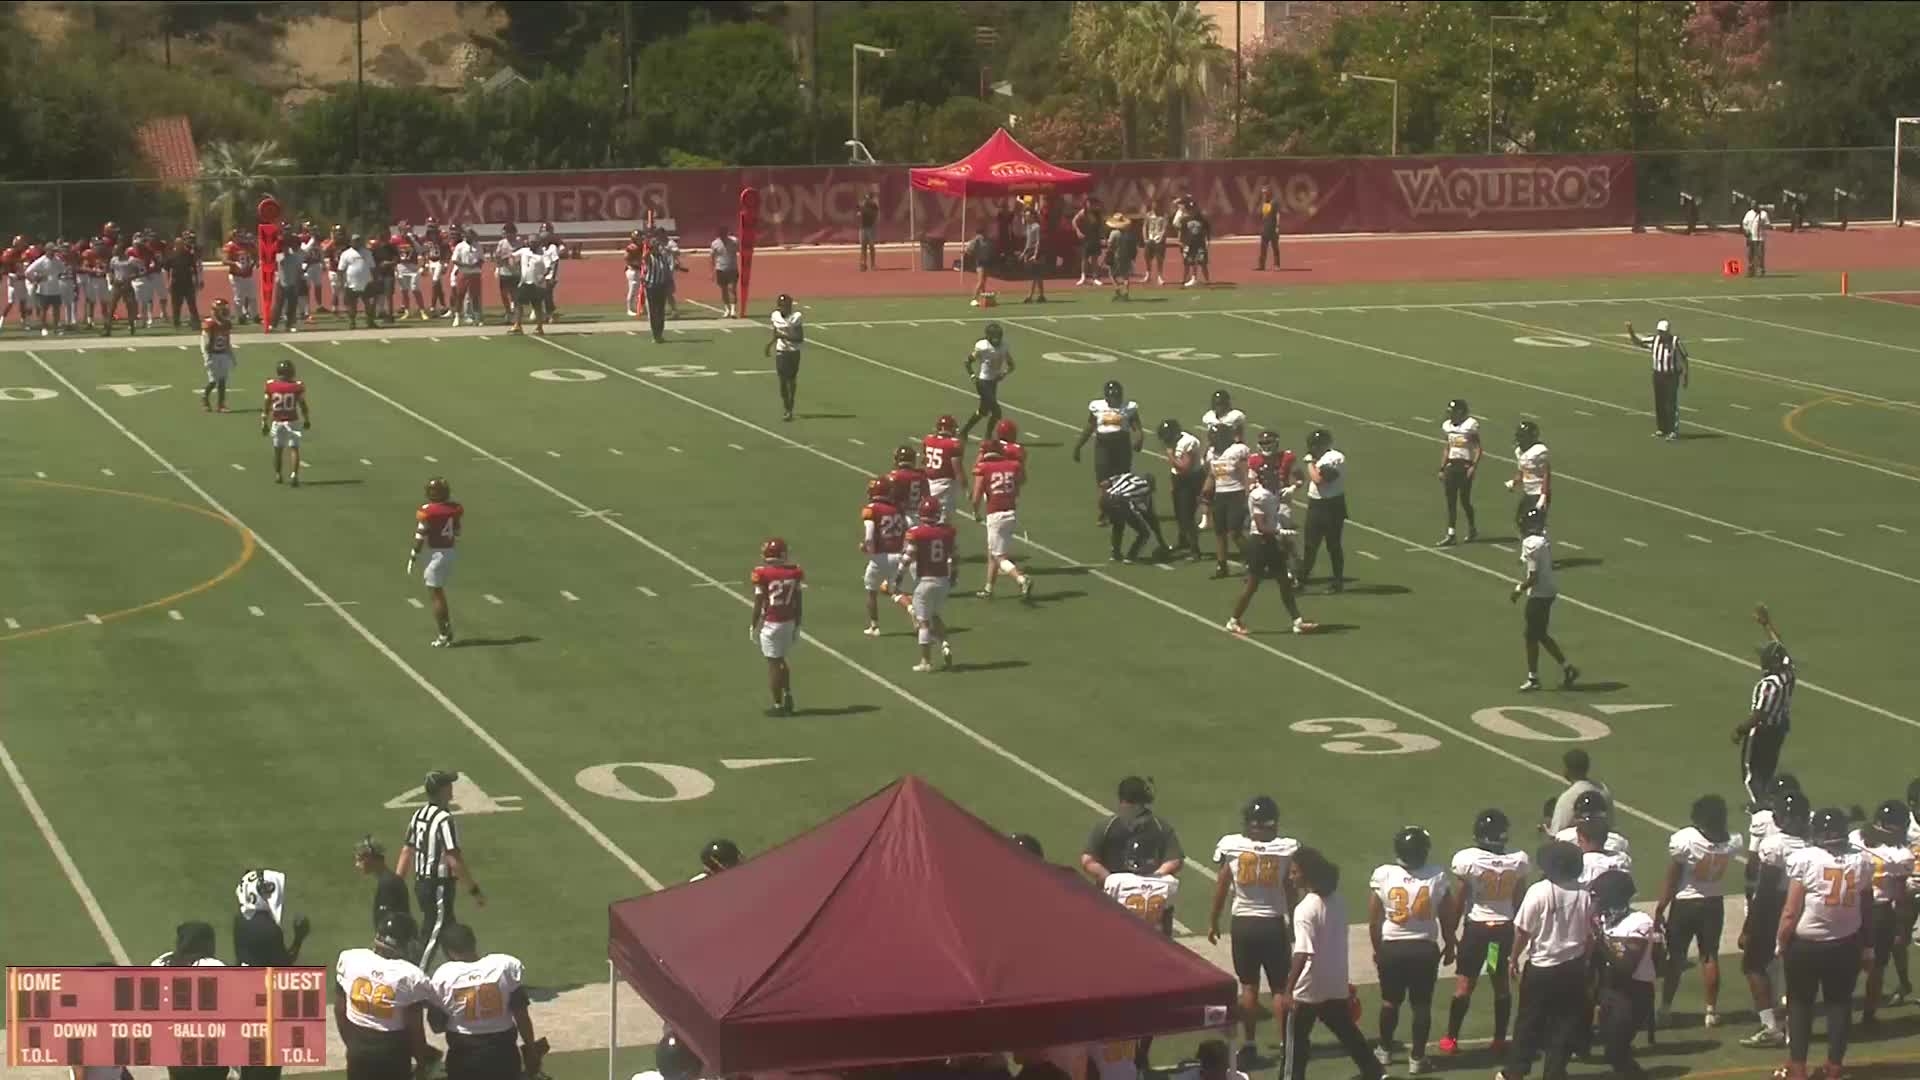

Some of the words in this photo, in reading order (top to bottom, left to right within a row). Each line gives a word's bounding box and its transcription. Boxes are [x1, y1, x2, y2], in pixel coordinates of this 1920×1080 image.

[418, 183, 669, 224] VAQUEROS
[1393, 166, 1611, 217] VAQUEROS
[272, 392, 295, 411] 20
[925, 447, 943, 469] 55
[990, 472, 1015, 494] 25
[441, 517, 453, 539] 4
[768, 579, 796, 606] 27
[1387, 886, 1431, 925] 34
